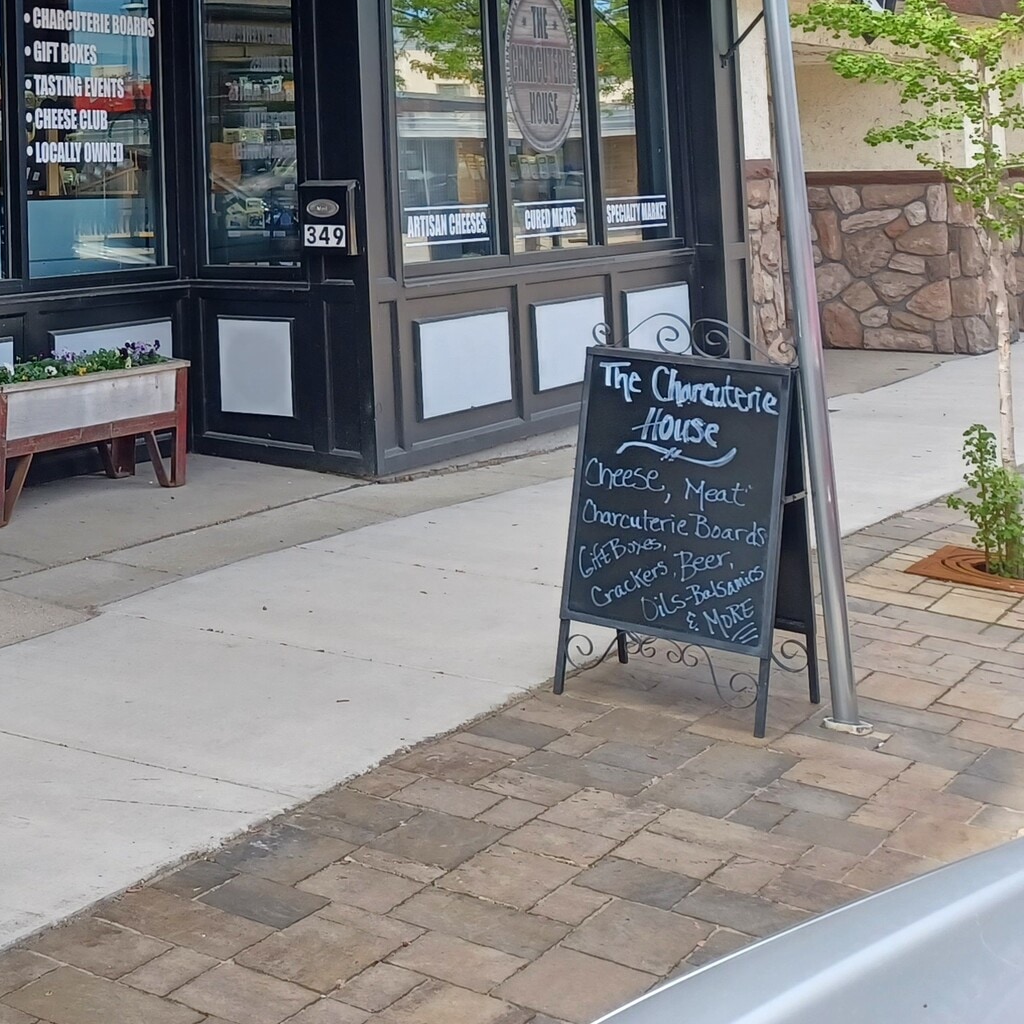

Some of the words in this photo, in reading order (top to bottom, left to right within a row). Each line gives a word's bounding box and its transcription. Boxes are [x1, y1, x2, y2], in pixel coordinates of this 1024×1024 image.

[32, 7, 110, 34] CHARCUTERIE
[112, 14, 155, 37] BOARDS
[530, 6, 549, 40] THE
[33, 40, 59, 63] GIFT
[61, 42, 97, 65] BOXES
[511, 43, 573, 85] CHARCUTERIE
[33, 74, 83, 97] TASTING
[84, 77, 125, 98] EVENTS
[34, 108, 77, 130] CHEESE
[79, 109, 108, 130] CLUB
[529, 91, 560, 125] HOUSE
[35, 142, 82, 164] LOCALLY
[84, 142, 124, 163] OWNED
[407, 214, 448, 238] ARTISAN
[448, 211, 487, 235] CHEESES
[525, 207, 551, 230] CURED
[552, 206, 577, 228] MEATS
[606, 203, 641, 223] SPECIALTY
[641, 201, 668, 221] MARKET
[306, 226, 344, 245] 349
[599, 361, 642, 402] The
[651, 365, 780, 415] Charcuterie
[632, 407, 720, 448] House
[585, 457, 671, 504] Cheese,
[582, 498, 689, 536] Charcuterie
[688, 513, 767, 547] Boards
